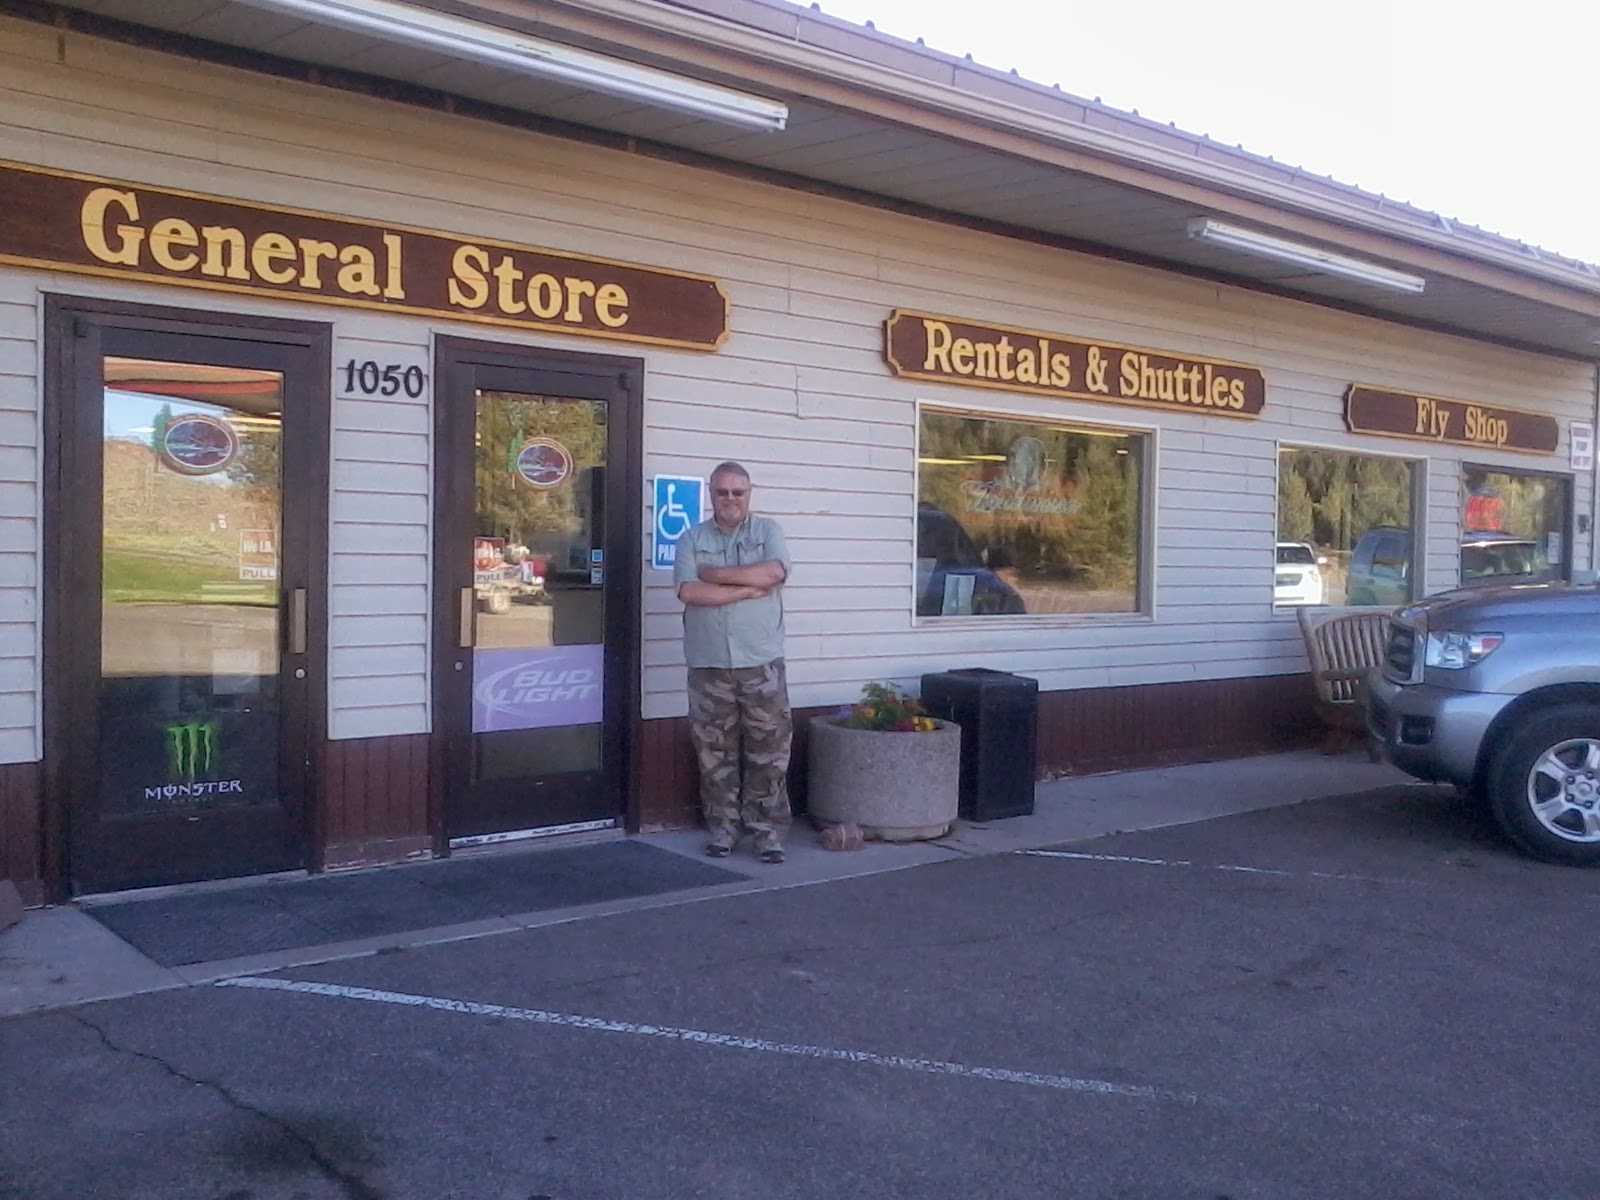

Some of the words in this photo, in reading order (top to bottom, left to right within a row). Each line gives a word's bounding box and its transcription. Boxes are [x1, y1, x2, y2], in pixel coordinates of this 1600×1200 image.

[80, 187, 406, 300] General
[447, 244, 630, 329] Store
[344, 359, 424, 399] 1050
[922, 319, 1071, 388] Rentals
[1085, 345, 1109, 393] &
[1119, 351, 1246, 410] Shuttles
[1415, 398, 1450, 441] Fly
[1464, 406, 1508, 448] Shop
[242, 569, 275, 578] PULL
[512, 669, 595, 688] BUD
[494, 684, 600, 704] LIGHT
[144, 780, 243, 801] MONSTER
